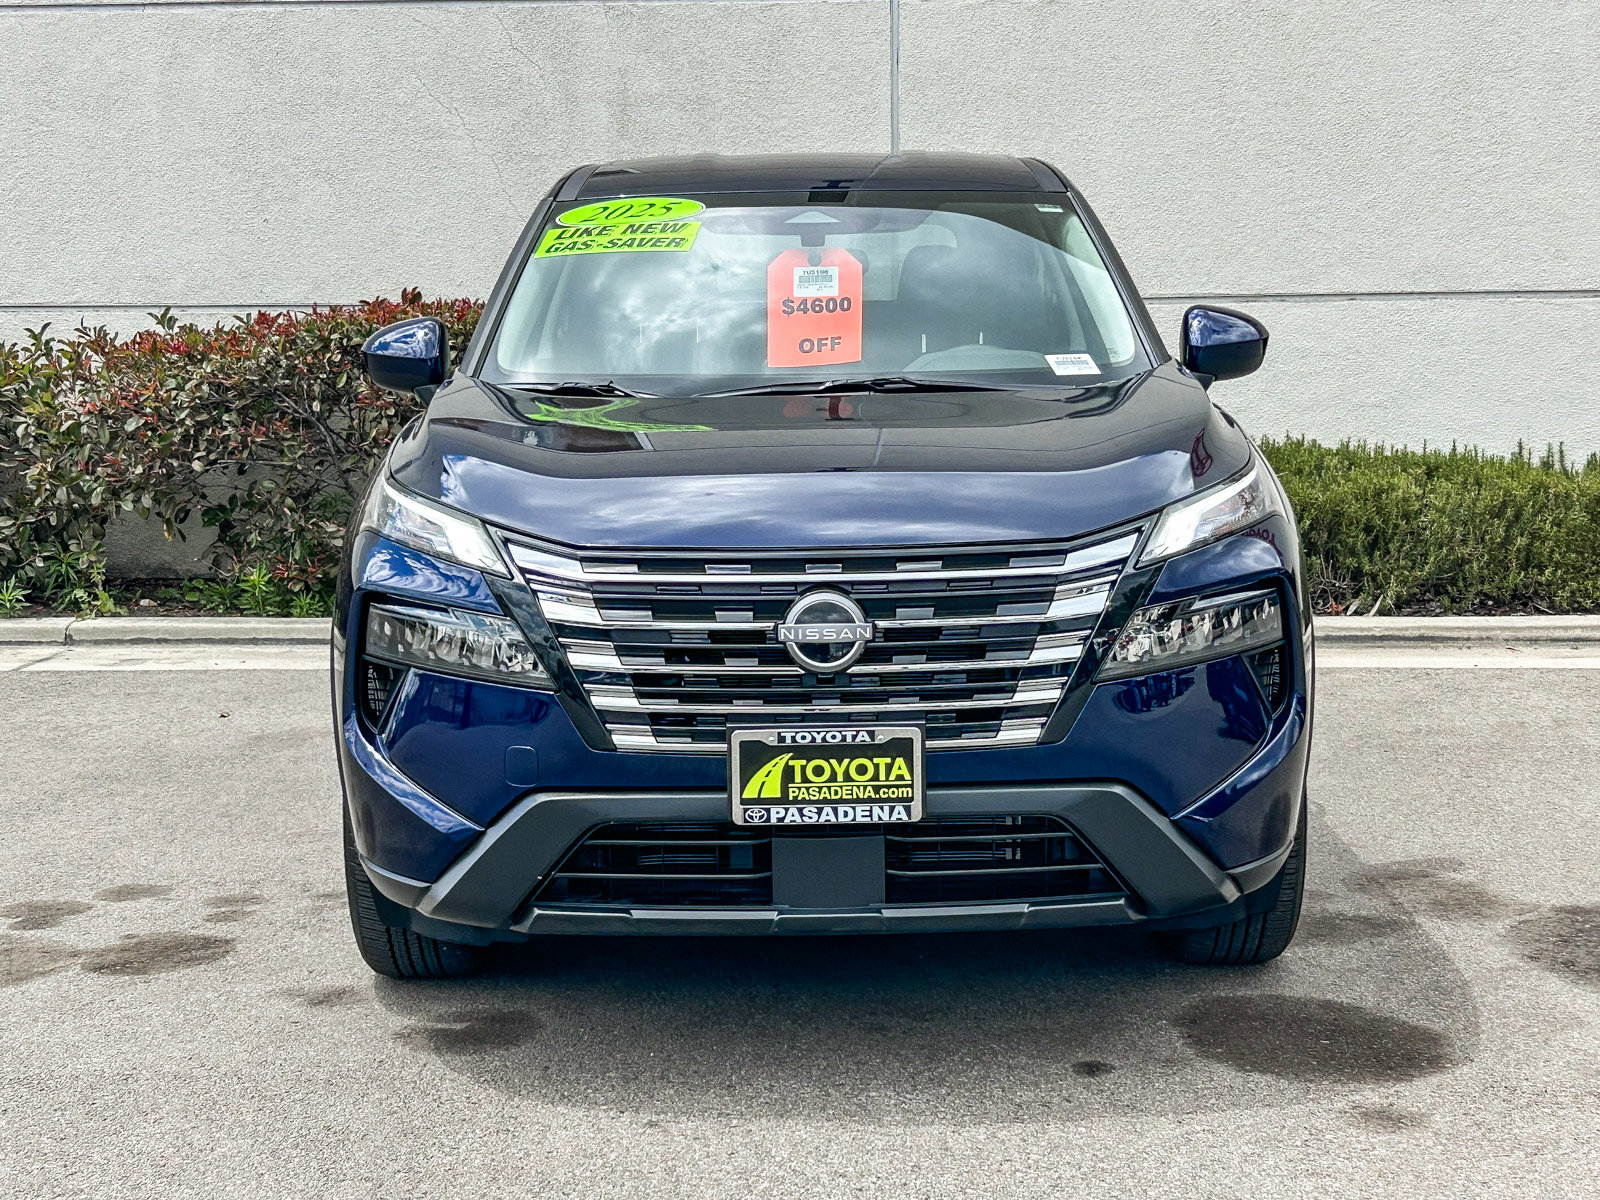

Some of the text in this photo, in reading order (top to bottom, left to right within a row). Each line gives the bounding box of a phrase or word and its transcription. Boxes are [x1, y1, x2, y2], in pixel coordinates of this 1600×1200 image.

[579, 201, 683, 223] 2025
[553, 221, 693, 241] LIKE NEW
[545, 236, 689, 254] GAS-SAVER
[782, 297, 852, 317] $4600
[798, 336, 842, 354] OFF
[780, 627, 871, 640] NISSAN
[780, 730, 872, 744] TOYOTA
[788, 757, 912, 784] TOYOTA
[788, 785, 913, 801] PASADENA.com
[769, 805, 909, 823] PASADENA
